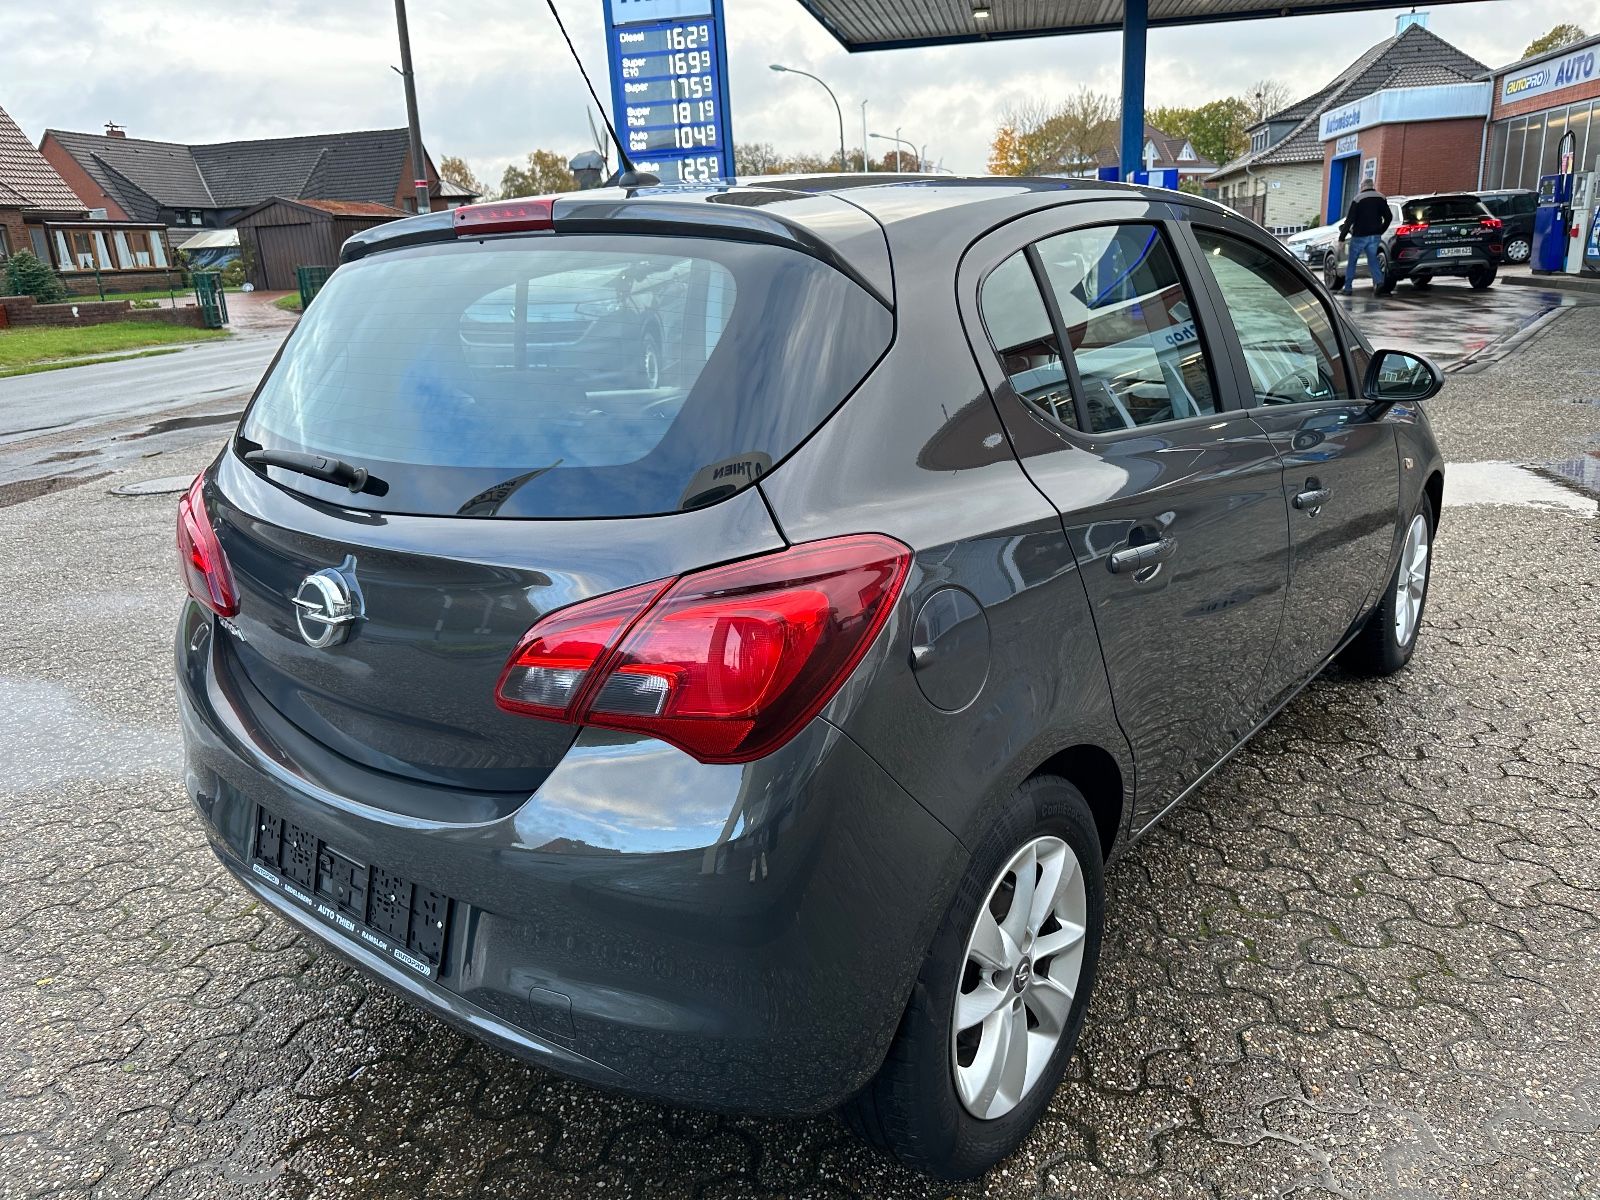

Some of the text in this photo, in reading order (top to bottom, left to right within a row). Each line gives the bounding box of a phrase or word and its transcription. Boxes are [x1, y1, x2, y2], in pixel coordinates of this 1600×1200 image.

[620, 32, 644, 43] Diesel
[622, 57, 646, 69] Super
[623, 67, 639, 78] E10
[1554, 52, 1594, 86] AUTO
[624, 82, 648, 94] Super
[627, 106, 650, 118] Super
[627, 116, 645, 126] Plus
[630, 131, 648, 142] Auto
[630, 140, 647, 151] Gas
[317, 904, 335, 920] AUTO
[336, 914, 355, 932] THIEN
